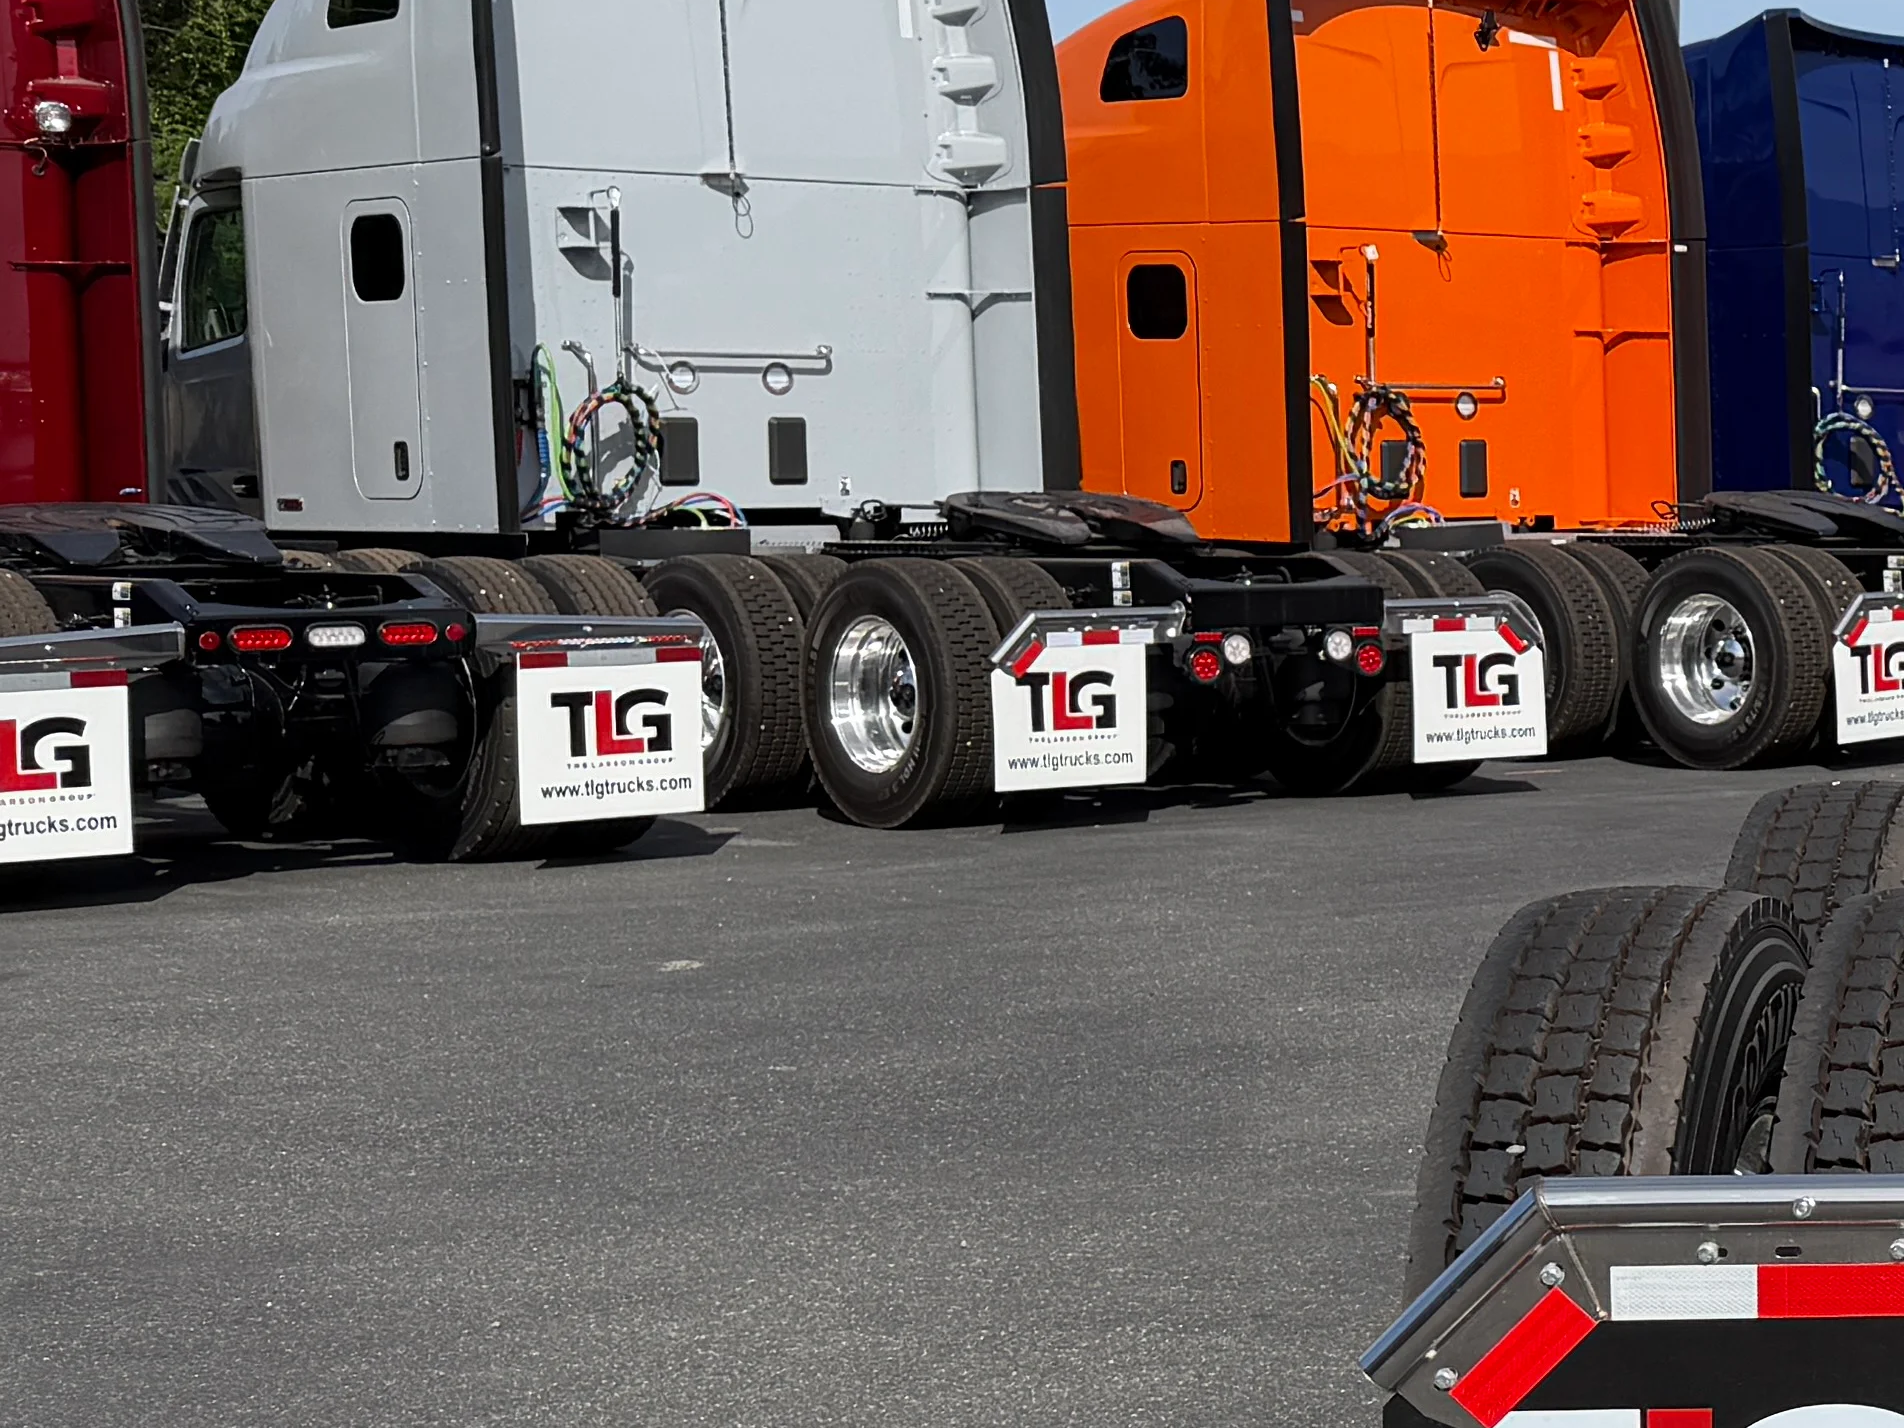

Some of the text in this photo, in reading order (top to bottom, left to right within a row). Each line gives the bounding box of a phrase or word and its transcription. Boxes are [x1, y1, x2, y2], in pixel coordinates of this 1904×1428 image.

[1015, 670, 1117, 732] TLG
[1432, 652, 1520, 709] TLG
[550, 688, 673, 757] TLG
[1426, 726, 1536, 745] www.tlgtrucks.com
[0, 716, 92, 792] LG
[1008, 750, 1134, 771] www.tlgtrucks.com
[541, 777, 693, 799] www.tlgtrucks.com
